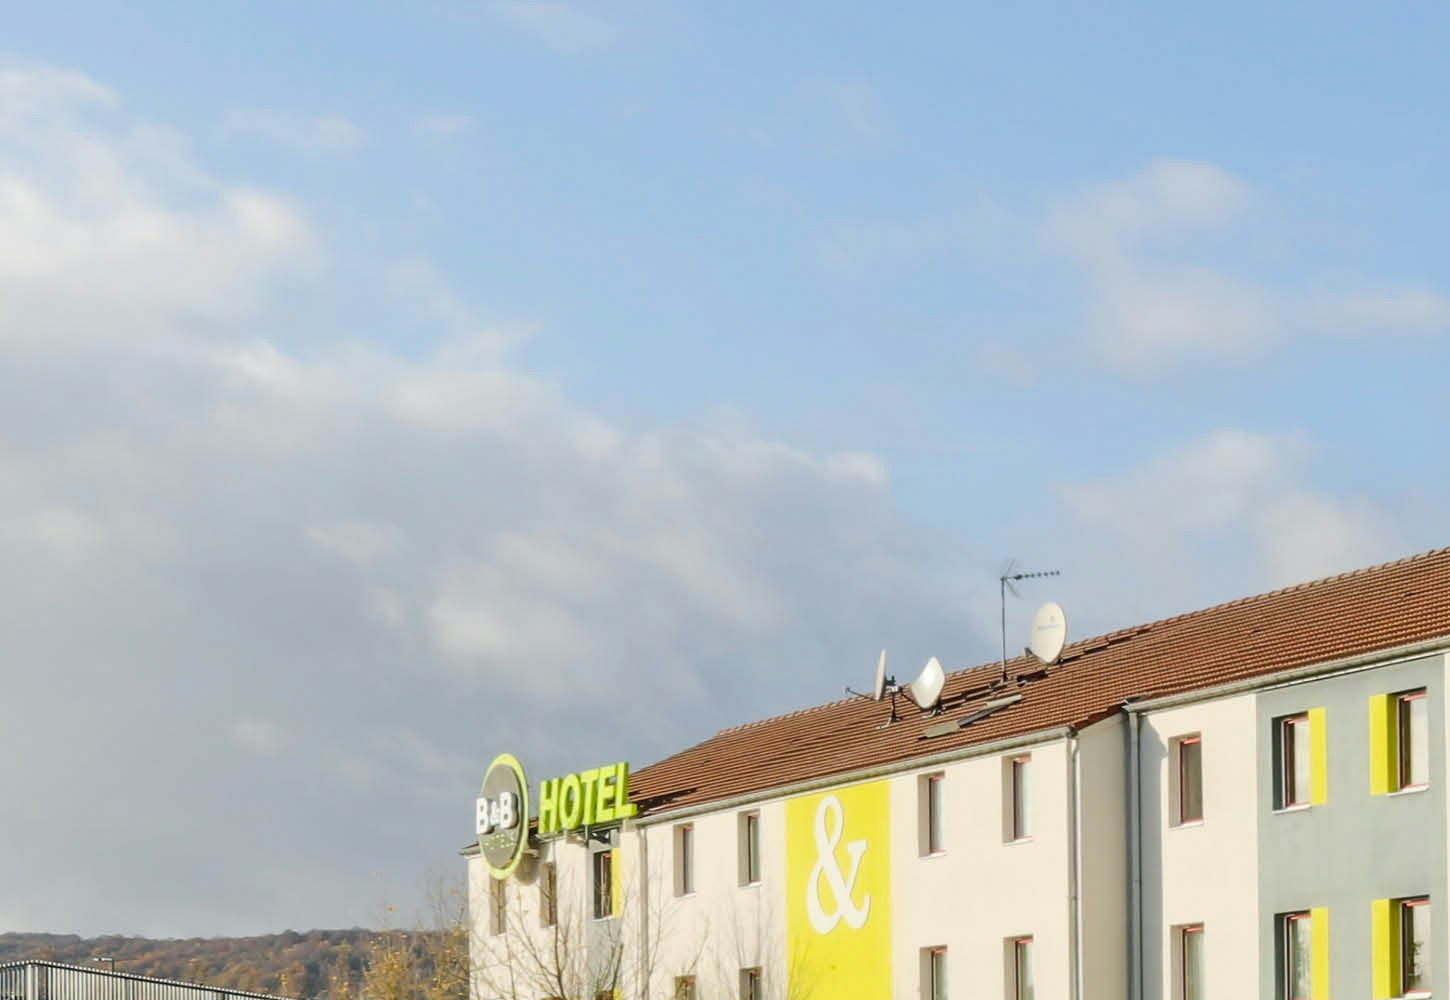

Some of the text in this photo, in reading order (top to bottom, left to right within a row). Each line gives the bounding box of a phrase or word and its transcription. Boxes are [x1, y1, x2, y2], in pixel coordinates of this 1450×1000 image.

[475, 791, 518, 835] B&B
[538, 761, 638, 834] HOTEL
[805, 795, 872, 936] &
